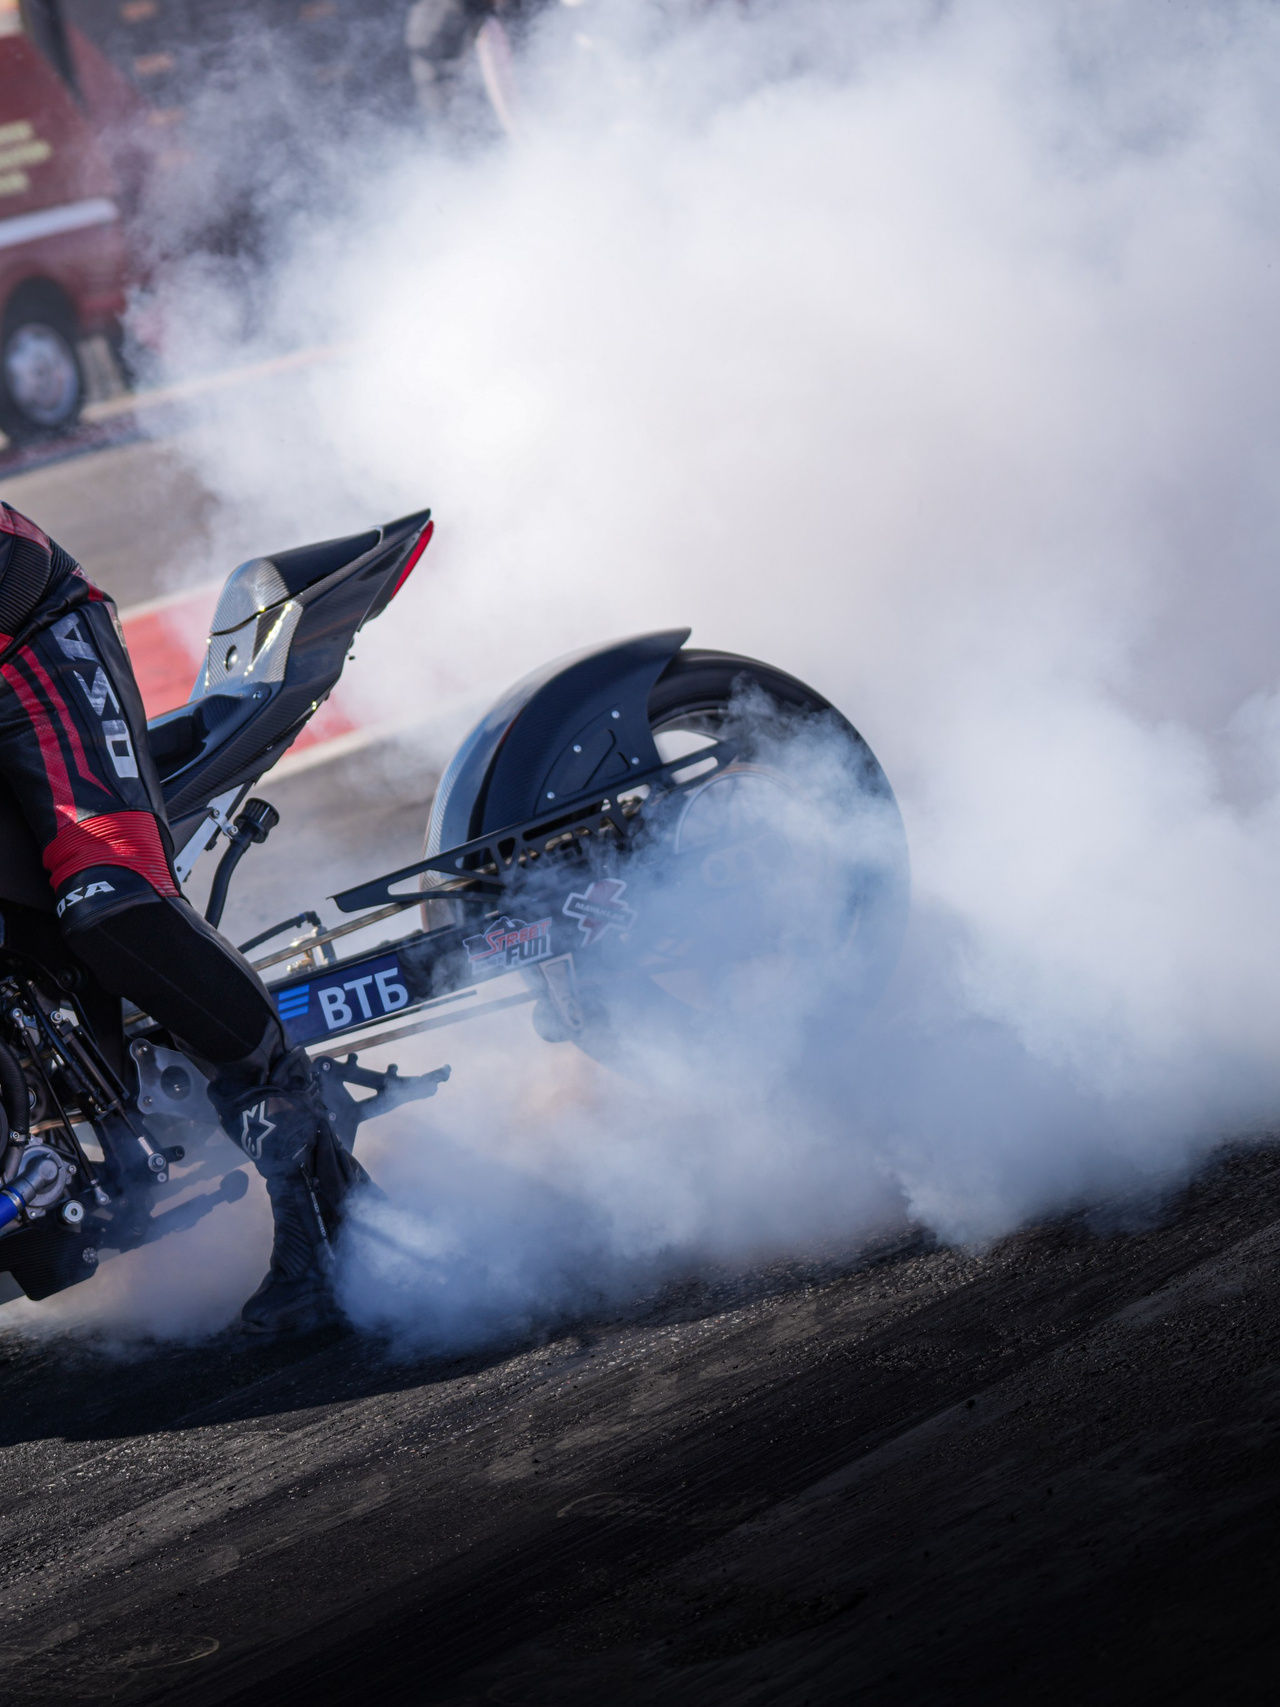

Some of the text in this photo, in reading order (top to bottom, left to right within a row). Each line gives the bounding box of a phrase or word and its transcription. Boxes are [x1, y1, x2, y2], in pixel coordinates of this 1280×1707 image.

[477, 920, 551, 956] STREET
[506, 936, 548, 966] FUN
[318, 967, 409, 1031] ВТБ
